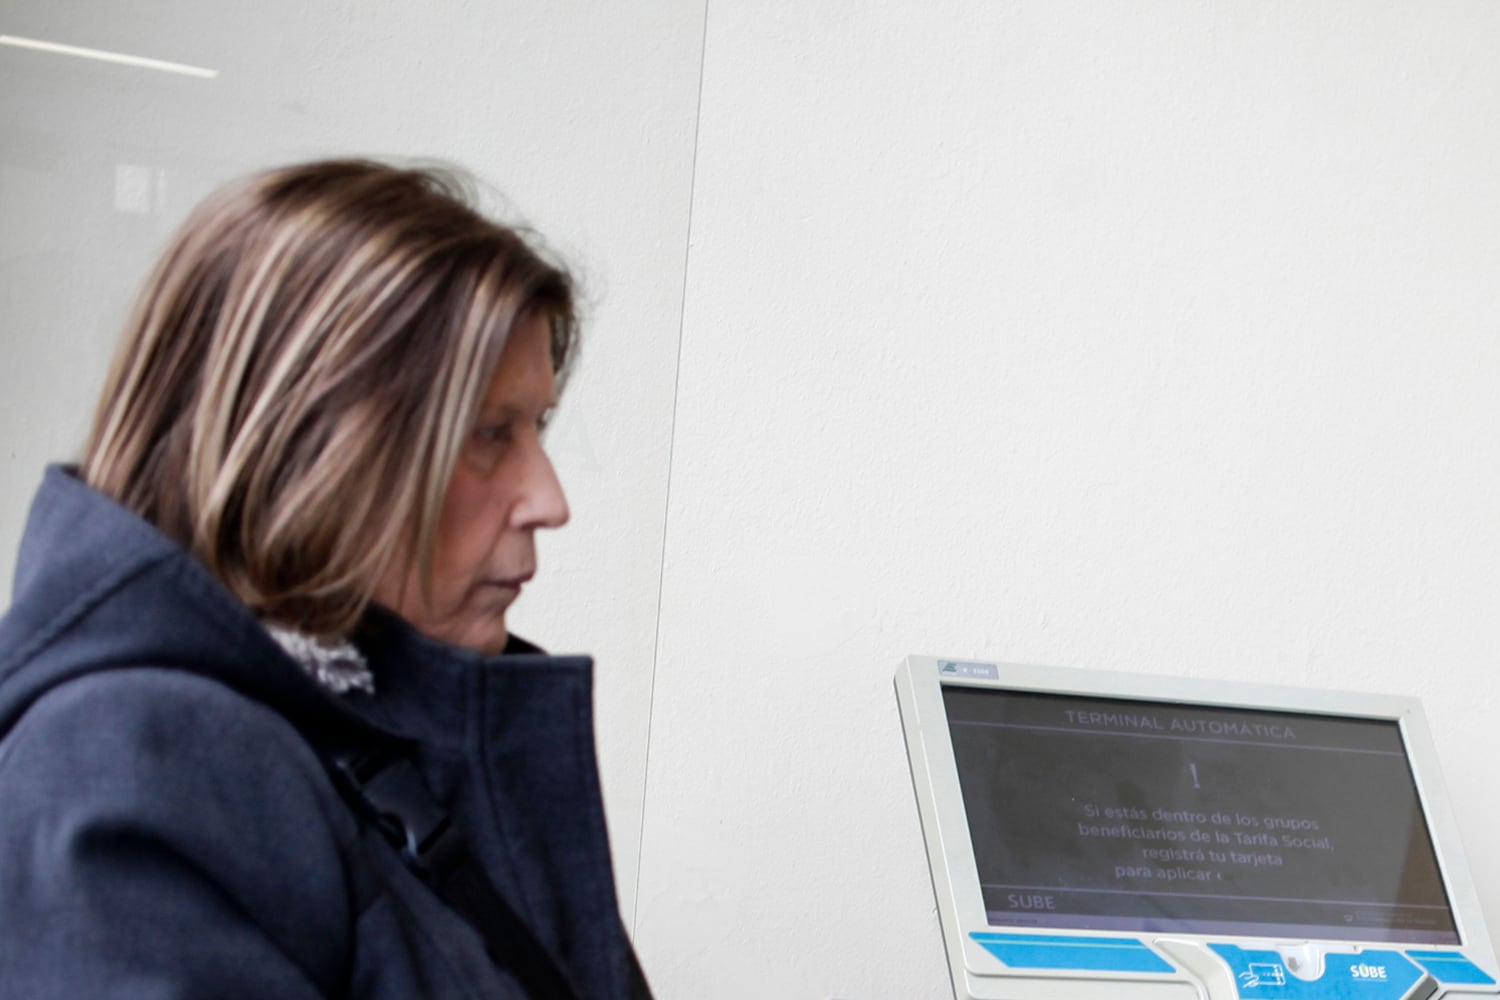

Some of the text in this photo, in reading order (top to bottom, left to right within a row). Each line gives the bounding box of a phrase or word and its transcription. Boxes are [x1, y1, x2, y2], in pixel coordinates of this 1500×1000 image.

[1064, 709, 1297, 740] TERMINAL AUTOMÁTICA
[1083, 803, 1100, 817] Si
[1152, 808, 1207, 825] dentro
[1211, 811, 1231, 826] de
[1235, 812, 1260, 828] los
[1264, 815, 1320, 832] grupos
[1077, 823, 1186, 842] beneficiarios
[1190, 829, 1211, 843] de
[1215, 831, 1230, 845] la
[1232, 831, 1279, 848] Tarifa
[1208, 850, 1227, 864] tu
[1230, 851, 1284, 868] tarjeta
[1114, 864, 1152, 879] para
[1156, 866, 1212, 881] aplicar
[1007, 893, 1056, 911] SUBE
[1350, 963, 1388, 979] SUBE
